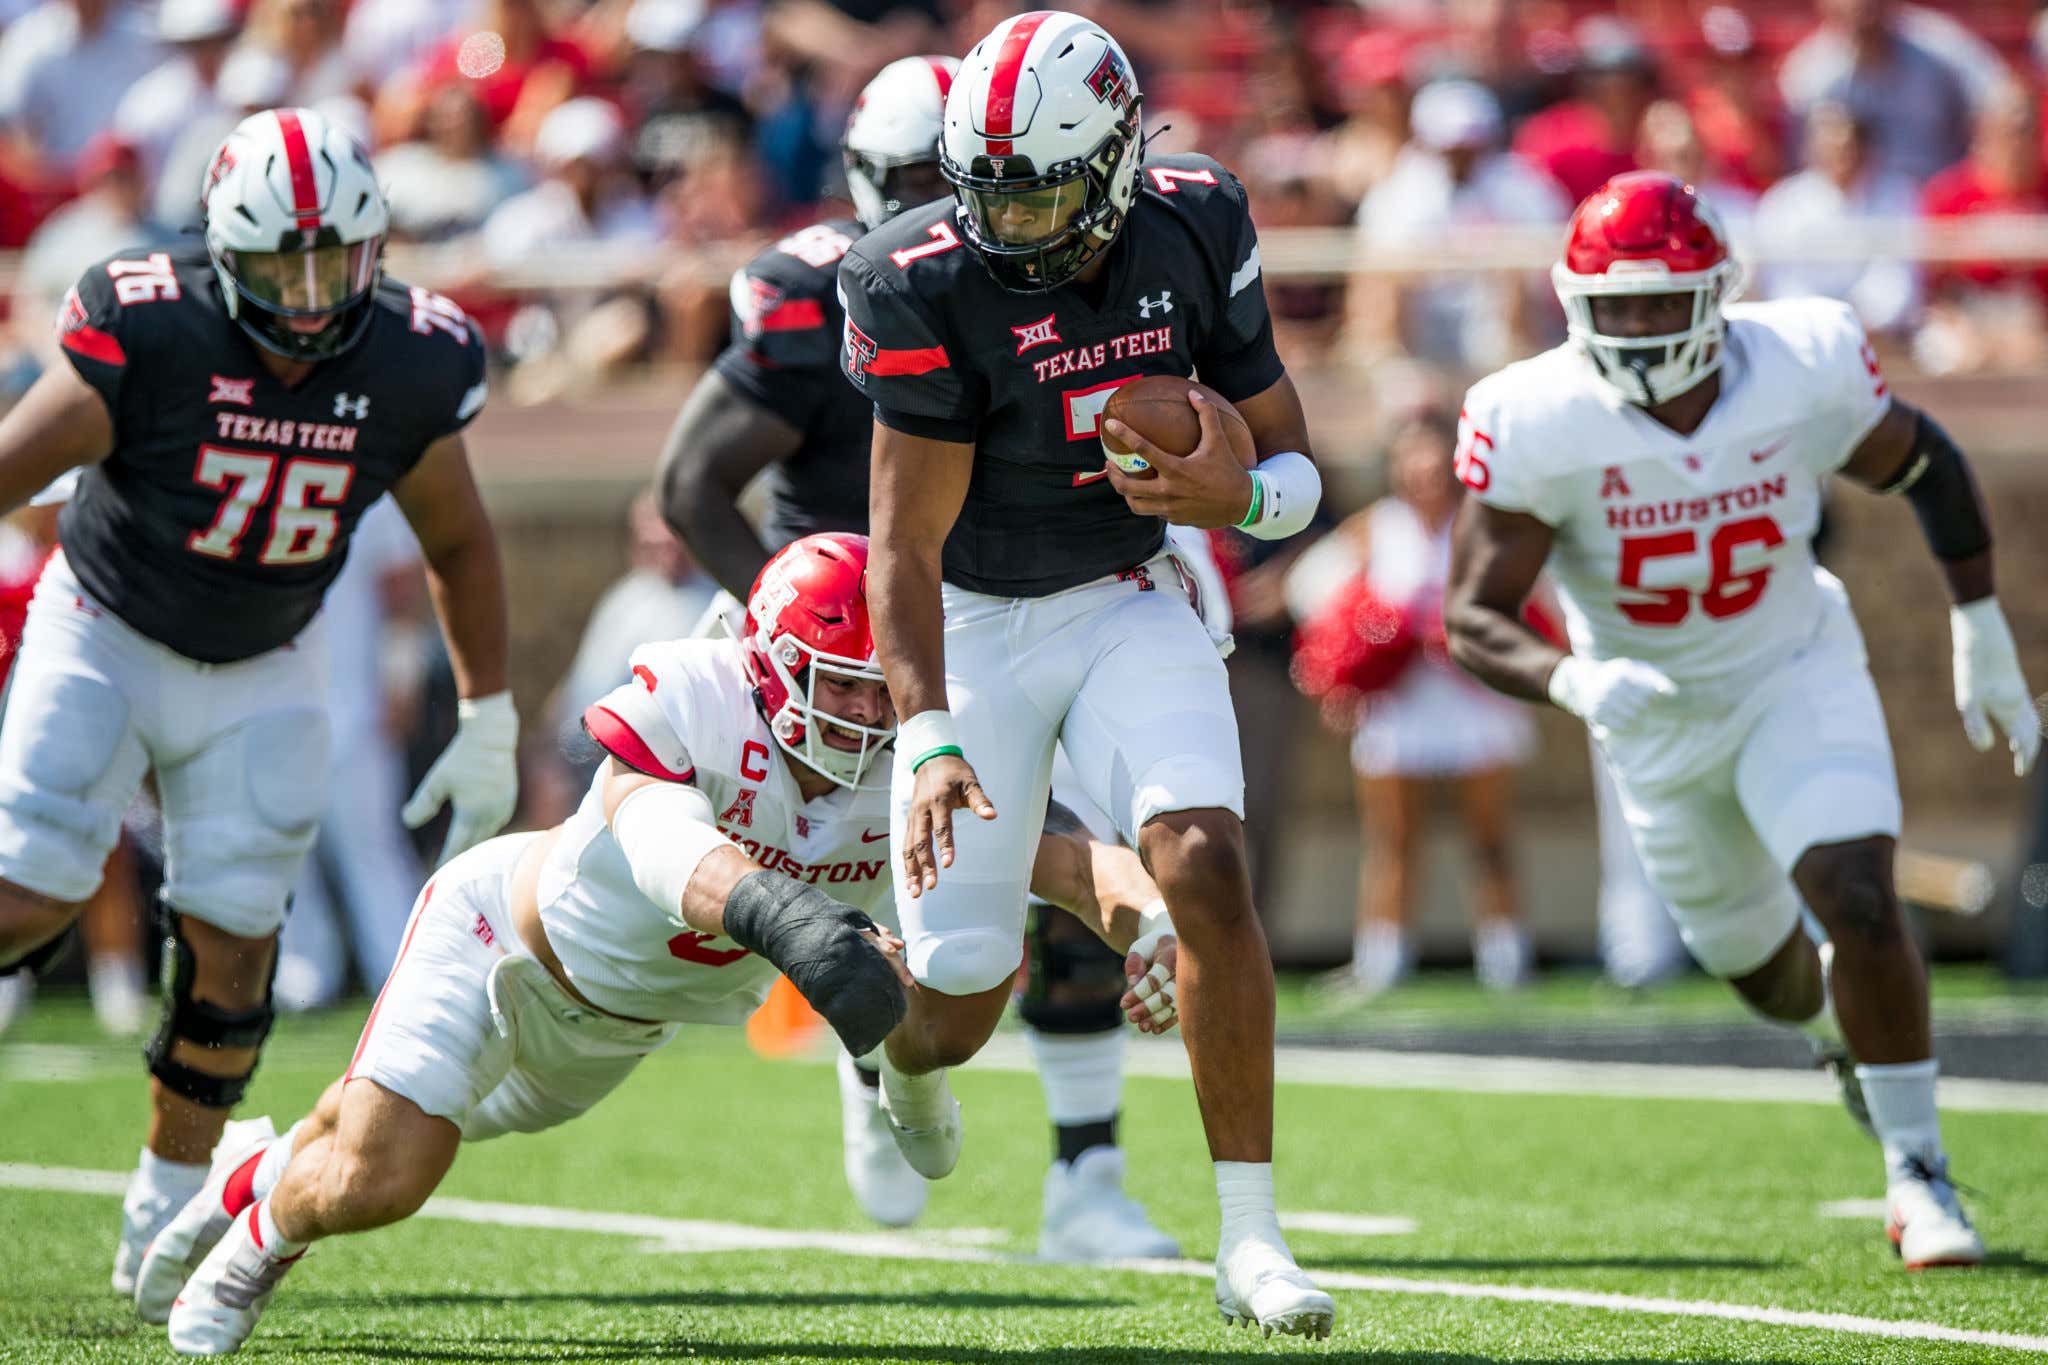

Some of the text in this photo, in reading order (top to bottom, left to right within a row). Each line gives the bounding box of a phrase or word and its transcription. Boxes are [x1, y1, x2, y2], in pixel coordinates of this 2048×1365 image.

[1148, 167, 1219, 195] 7
[888, 220, 963, 270] 7
[106, 253, 182, 307] 76
[1033, 326, 1172, 384] TEXAS TECH
[216, 412, 358, 452] TEXAS TECH
[187, 442, 356, 566] 76
[1605, 473, 1786, 529] HOUSTON
[1616, 515, 1785, 628] 56
[740, 739, 770, 783] C
